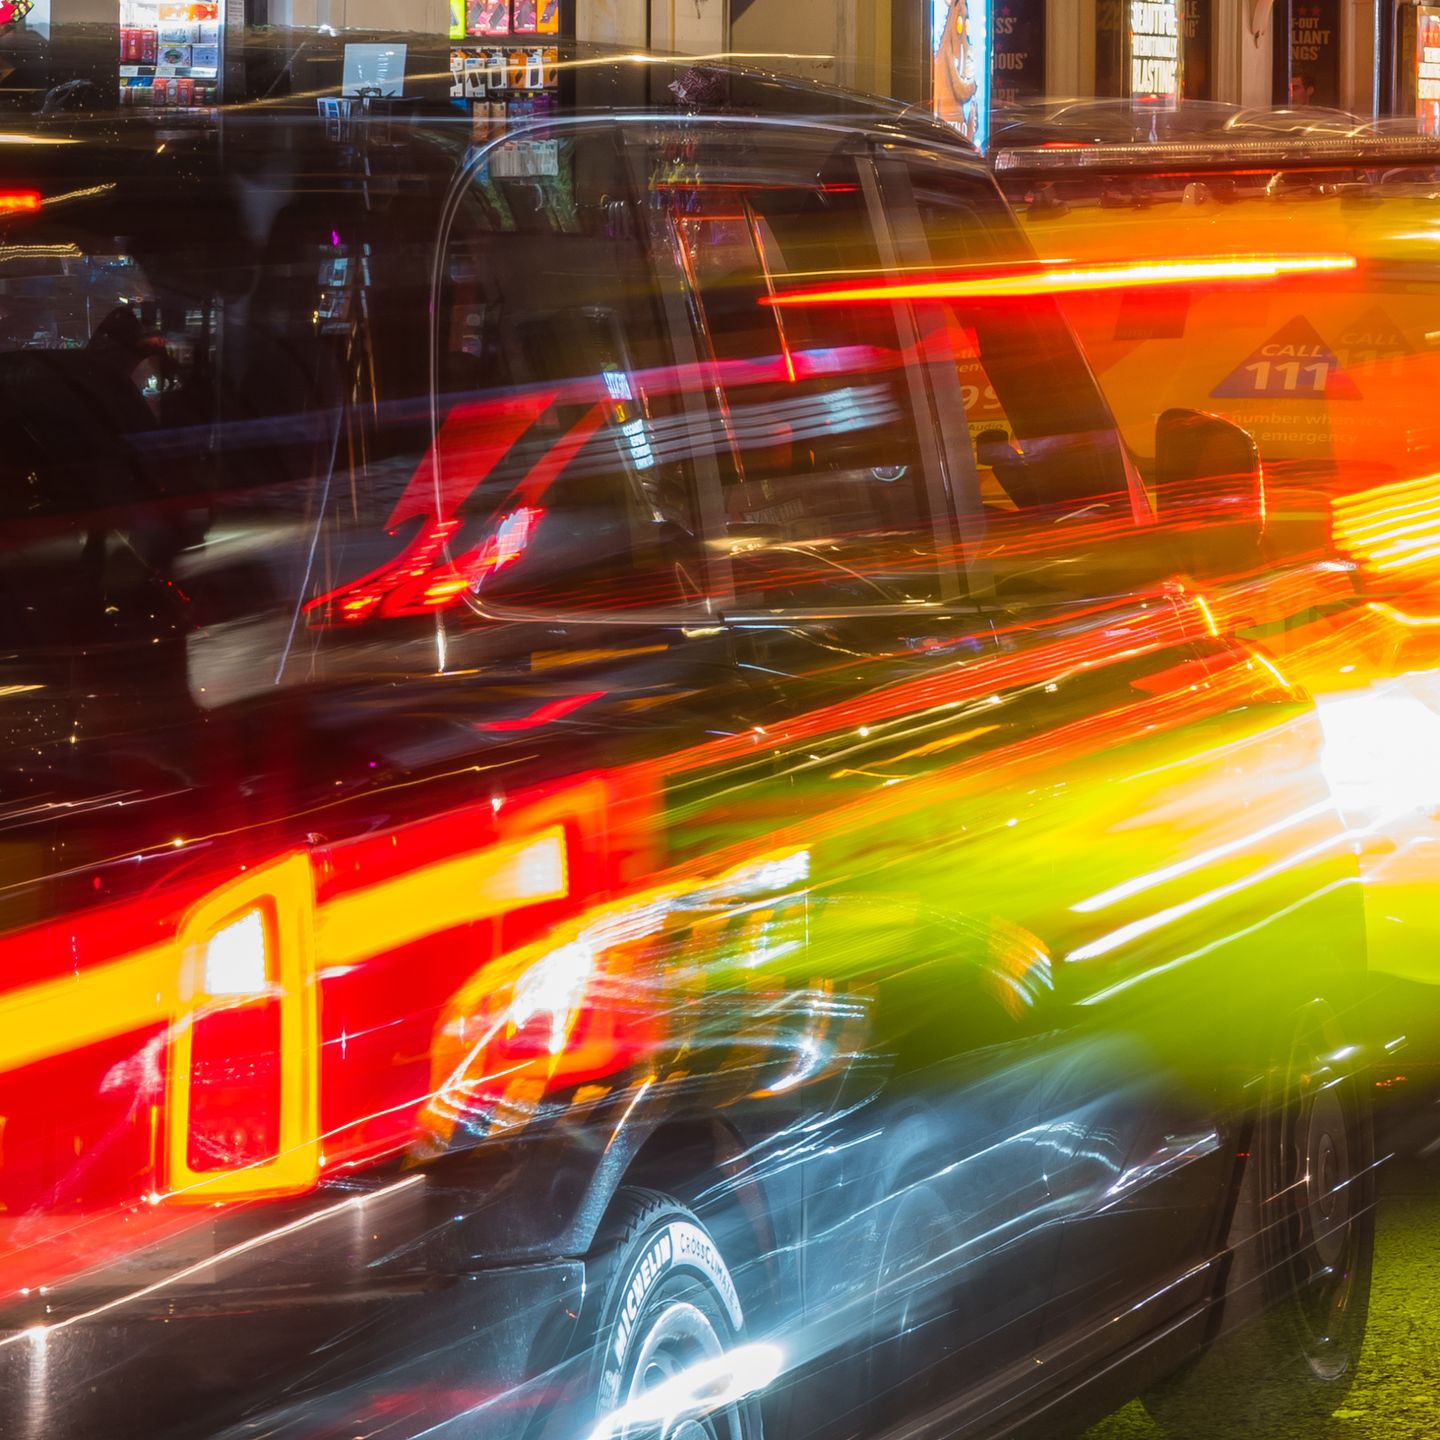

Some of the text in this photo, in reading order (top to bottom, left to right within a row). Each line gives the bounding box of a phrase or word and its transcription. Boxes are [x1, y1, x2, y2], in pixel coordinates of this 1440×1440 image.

[1261, 343, 1325, 358] CALL
[1244, 360, 1330, 391] 111
[1232, 413, 1300, 425] number
[614, 1233, 672, 1366] MICHELIN
